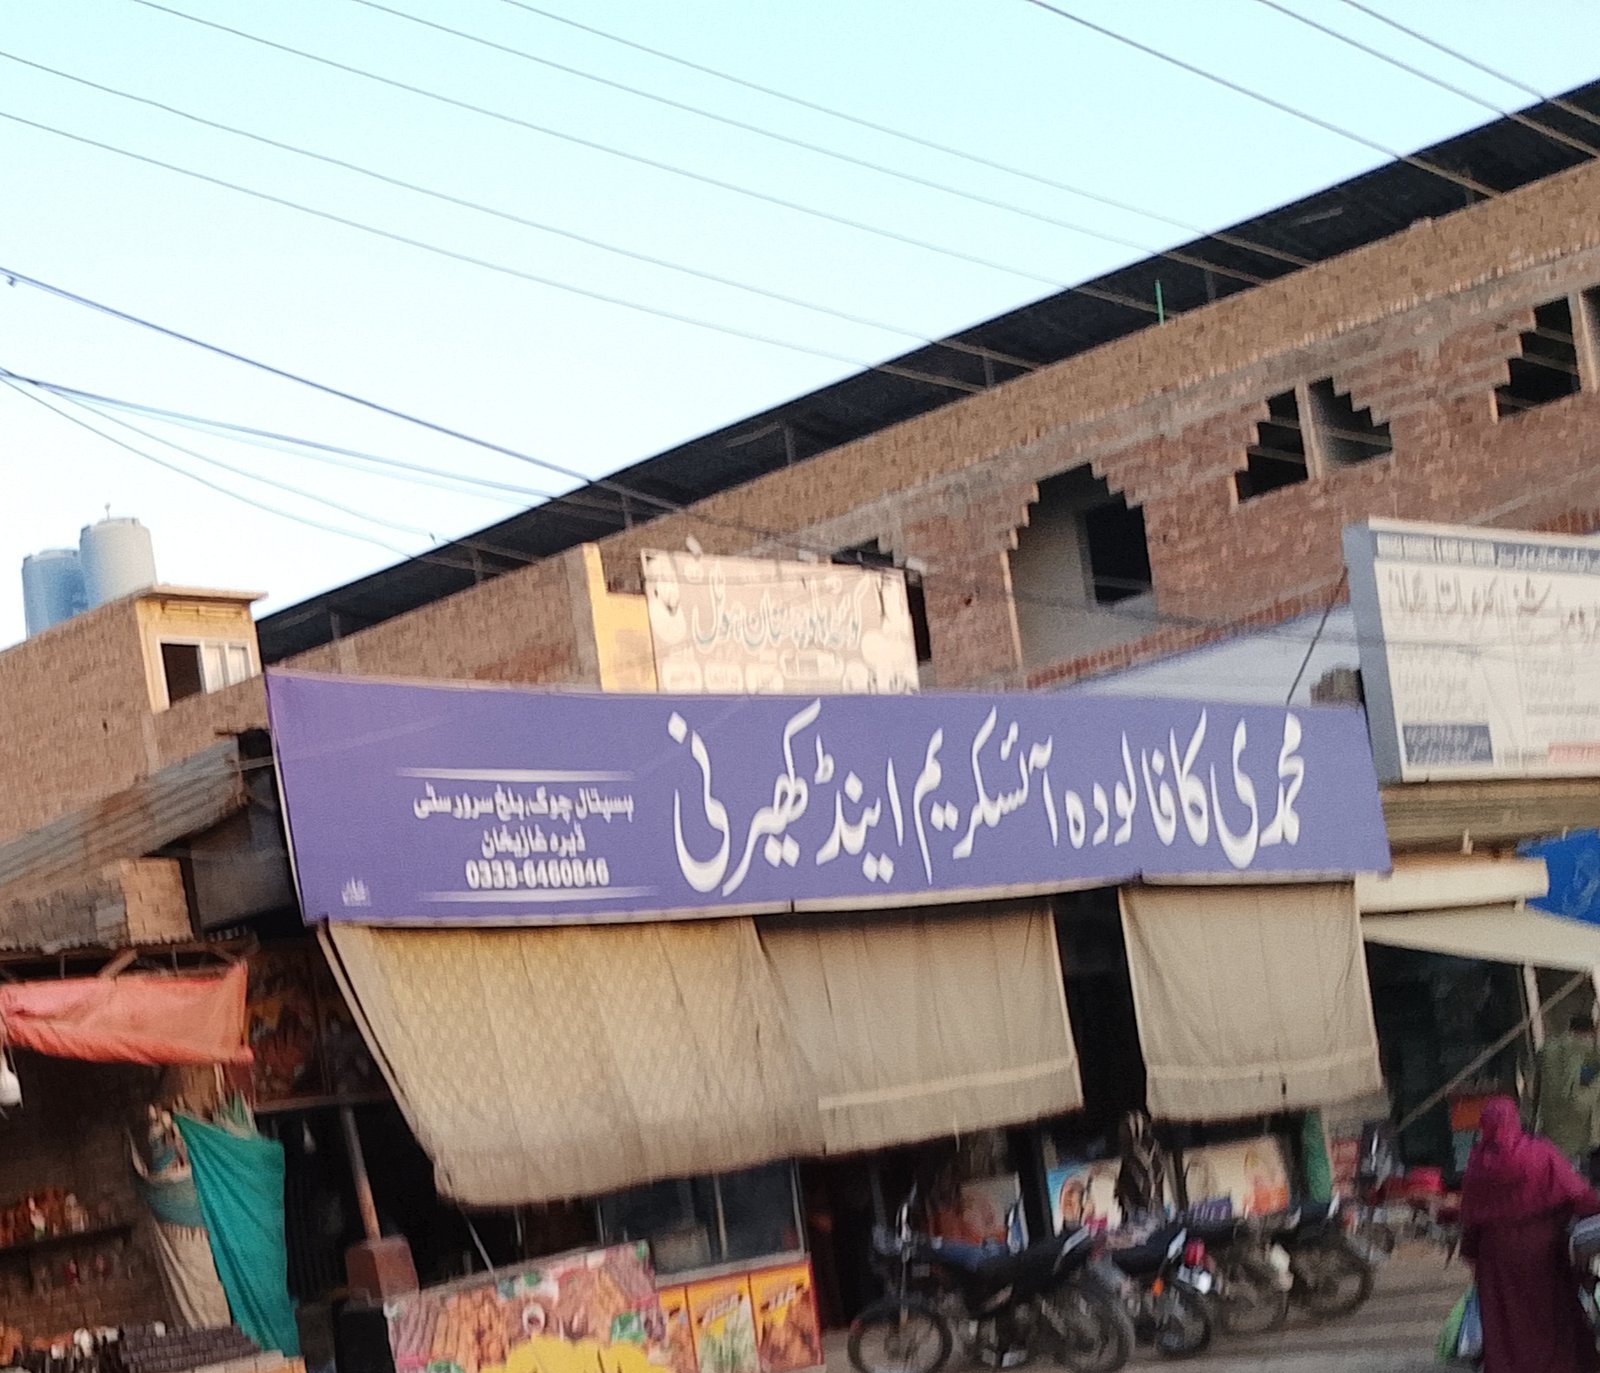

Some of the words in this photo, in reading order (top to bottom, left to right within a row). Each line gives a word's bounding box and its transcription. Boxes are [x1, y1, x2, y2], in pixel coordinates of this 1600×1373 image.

[814, 733, 906, 884] اینڈ
[1168, 706, 1211, 848] کا
[1208, 711, 1306, 870] محمدی
